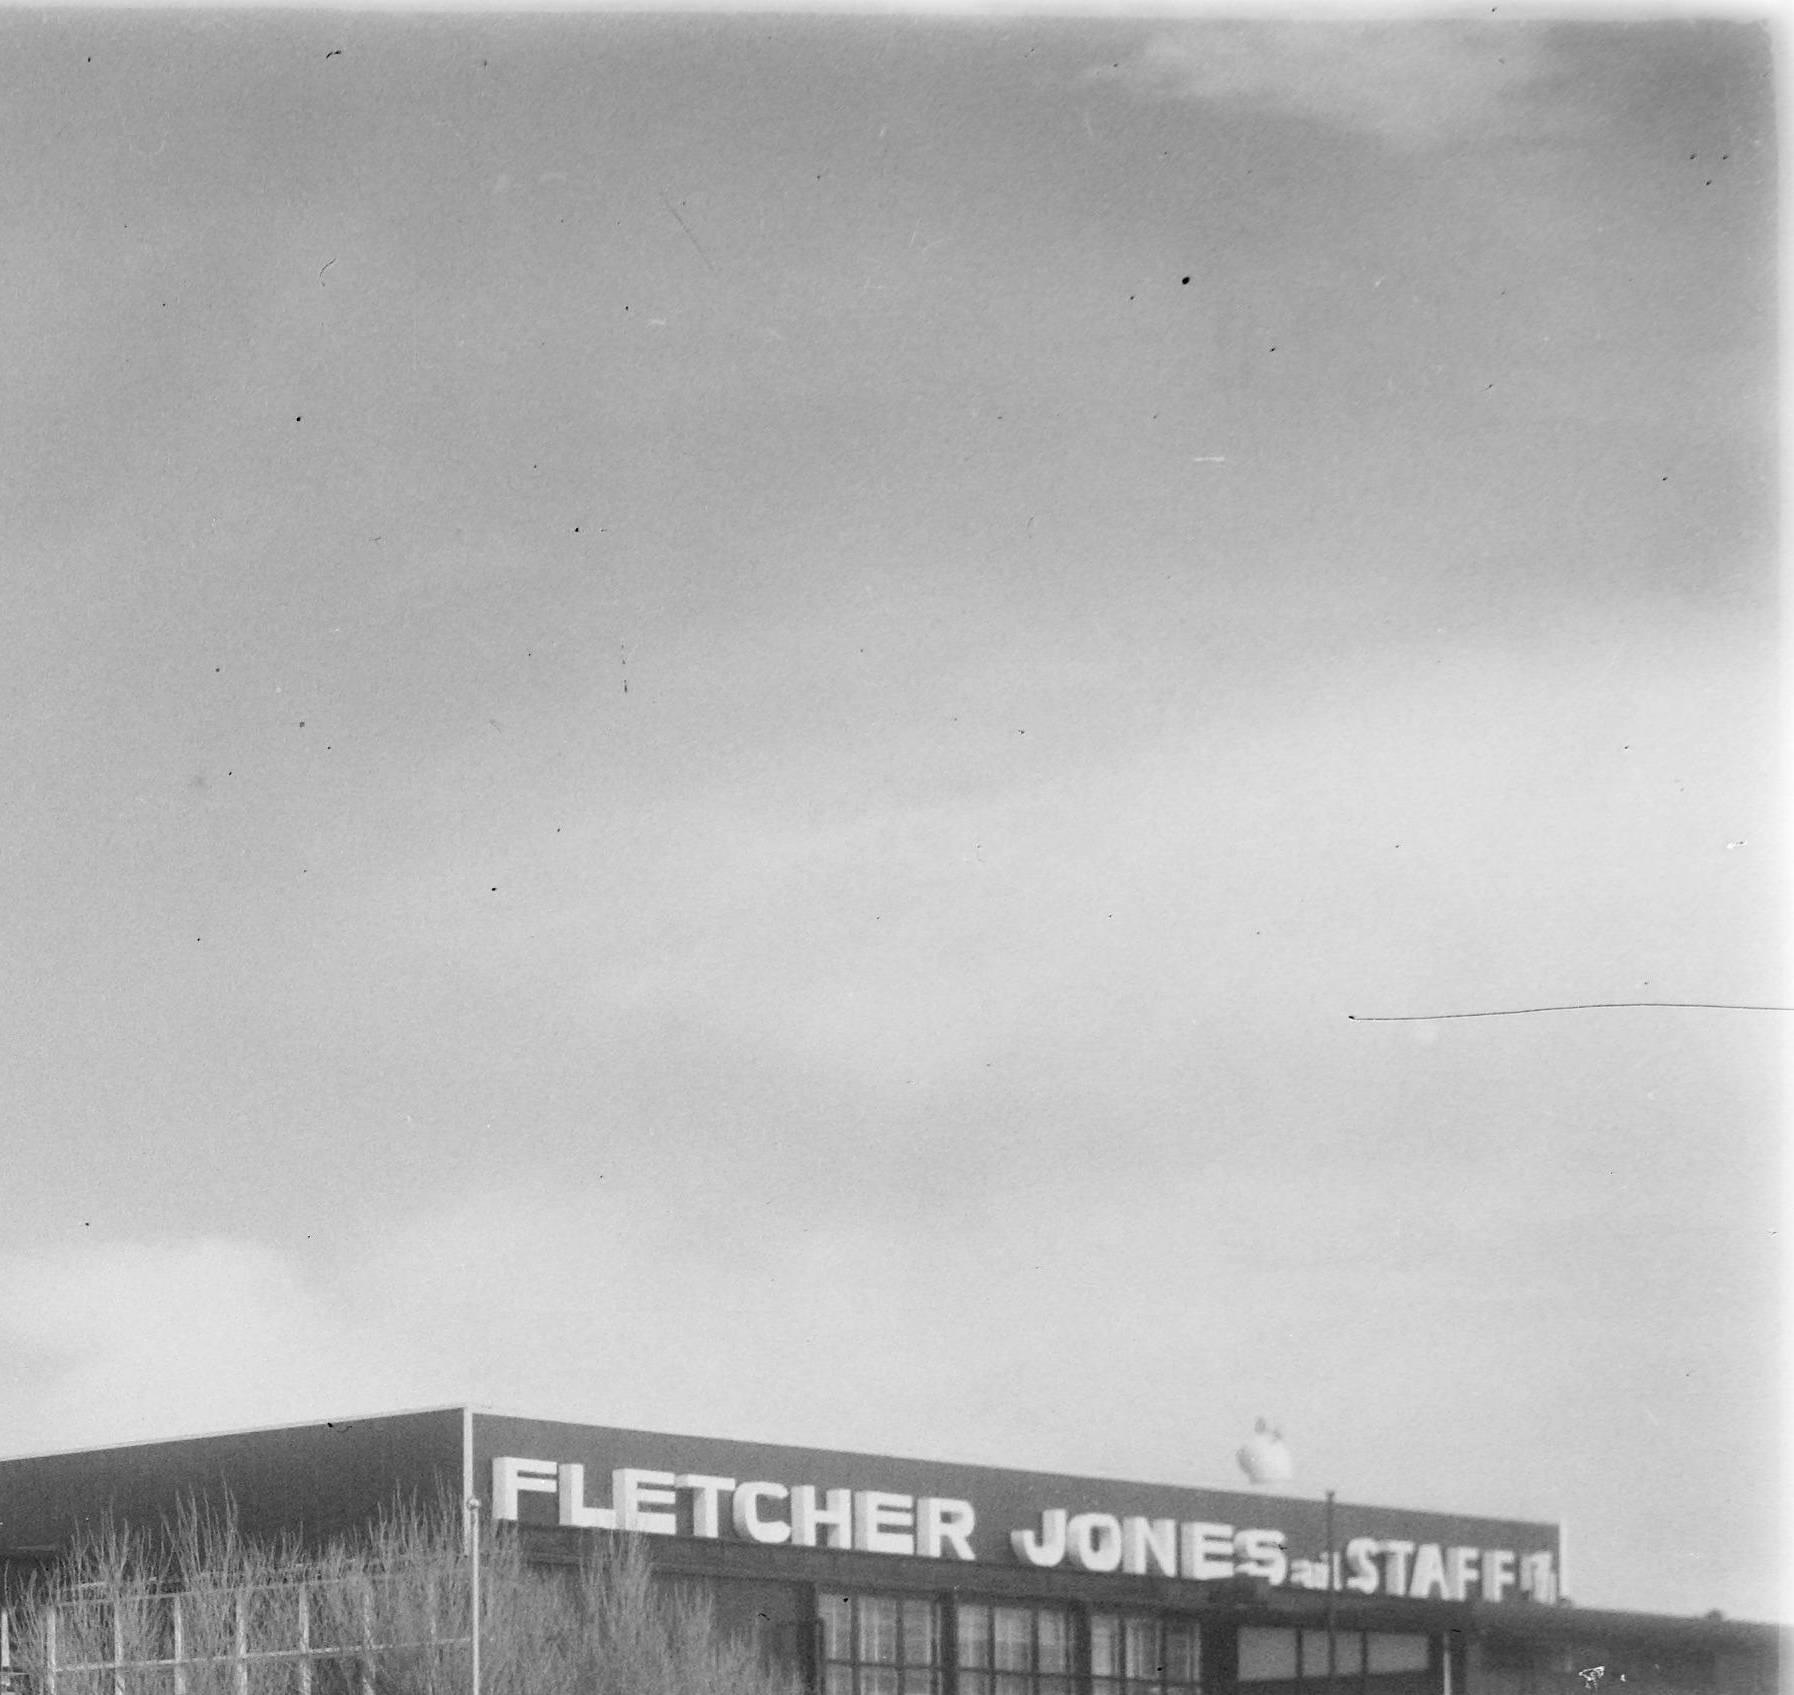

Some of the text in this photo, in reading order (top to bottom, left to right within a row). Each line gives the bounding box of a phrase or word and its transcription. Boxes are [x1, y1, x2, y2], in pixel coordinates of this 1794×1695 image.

[492, 1455, 976, 1560] FLETCHER
[1011, 1508, 1287, 1588] JONES
[1347, 1537, 1514, 1602] STAFF
